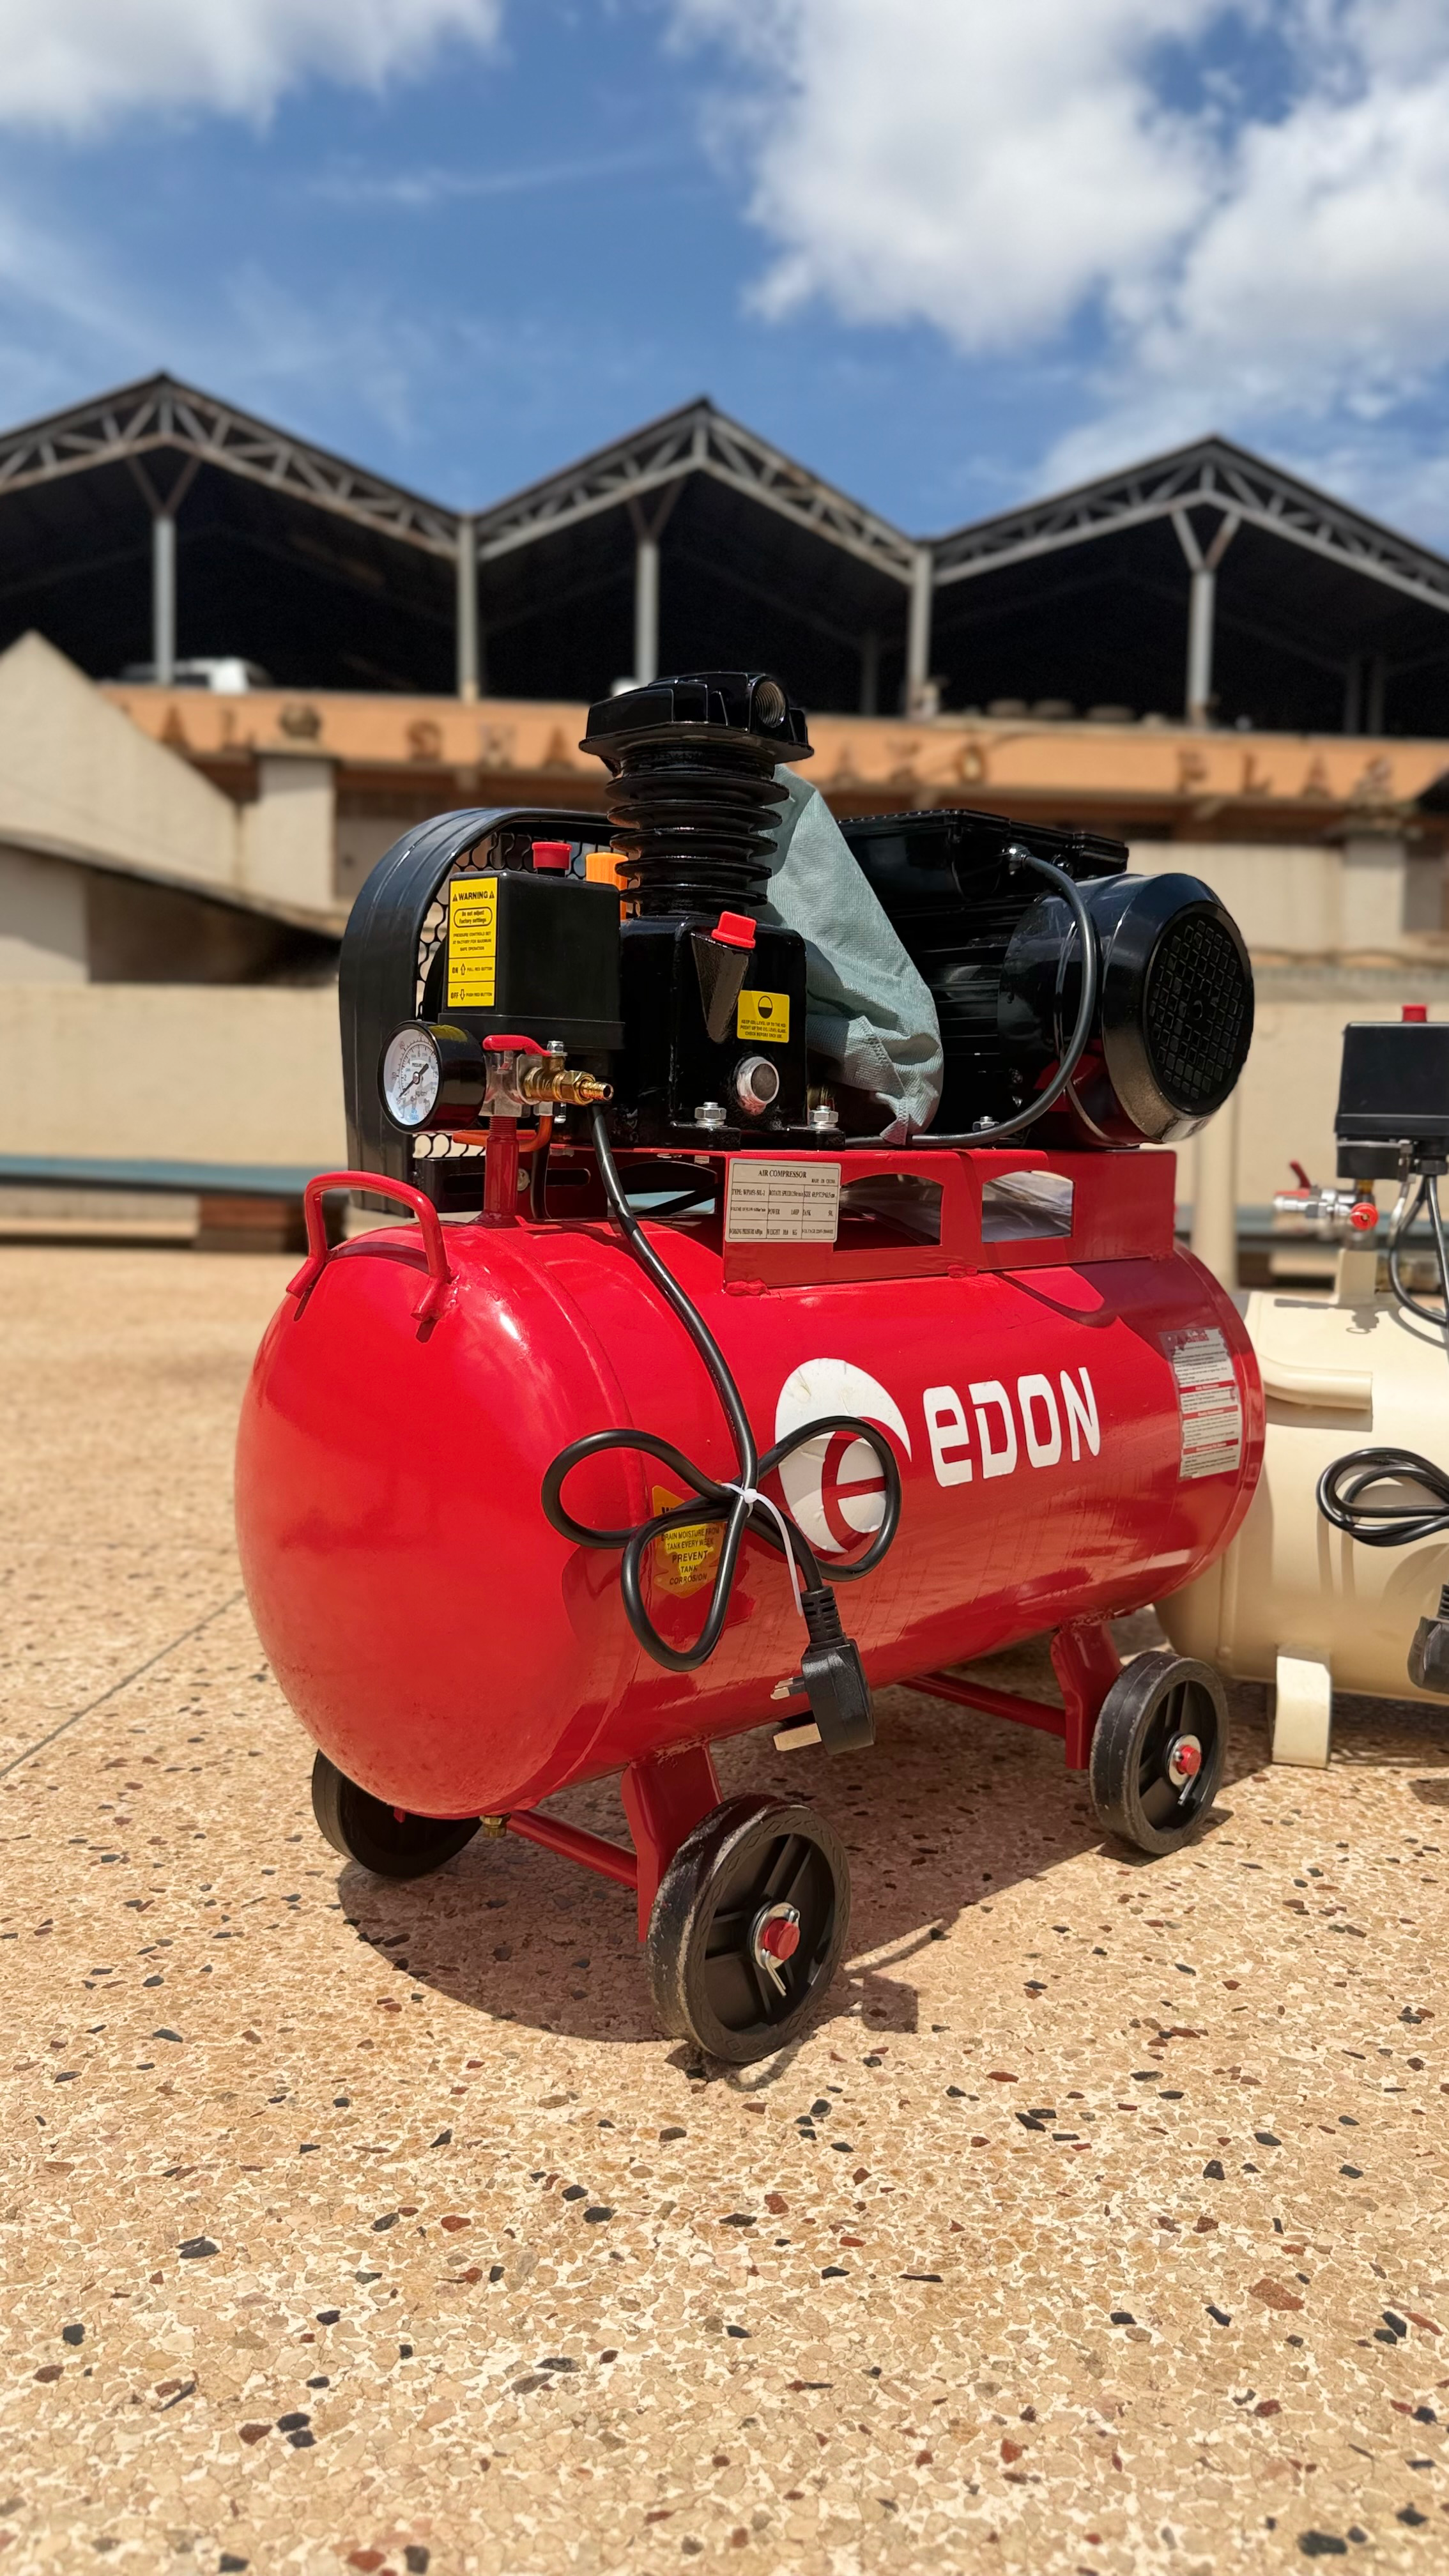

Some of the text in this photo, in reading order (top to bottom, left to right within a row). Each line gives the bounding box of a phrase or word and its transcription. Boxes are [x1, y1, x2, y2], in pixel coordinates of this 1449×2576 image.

[459, 891, 488, 900] WARNING
[769, 1170, 807, 1178] COMPRESSOR
[661, 1527, 720, 1541] DRAIN MOISTURE FROM
[667, 1537, 714, 1550] TANK EVERY WEEK
[671, 1550, 708, 1563] PREVENT
[680, 1565, 698, 1573] TANK
[670, 1573, 707, 1584] CORROSION
